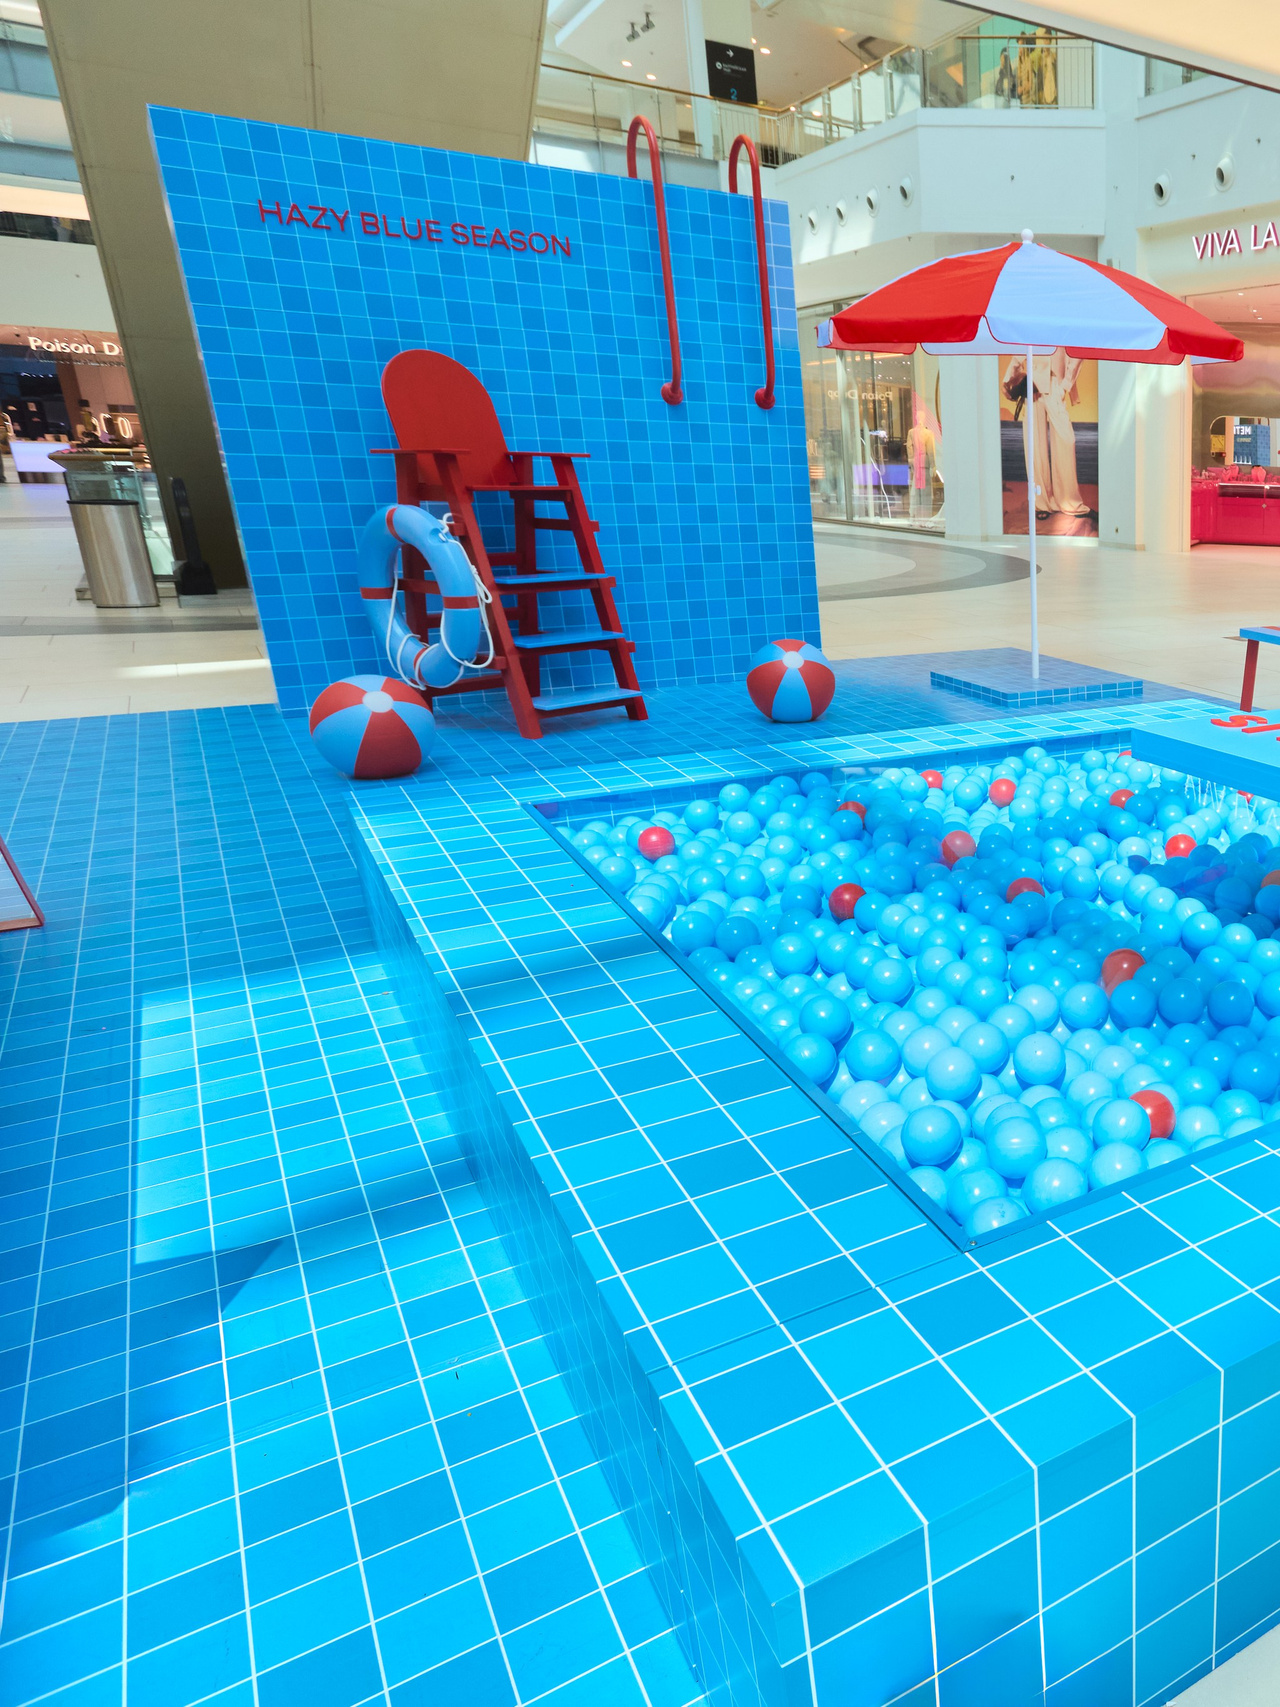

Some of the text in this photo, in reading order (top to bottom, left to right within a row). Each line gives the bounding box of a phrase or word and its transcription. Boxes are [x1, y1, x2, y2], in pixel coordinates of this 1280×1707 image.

[730, 88, 737, 100] 2
[257, 199, 571, 257] HAZY BLUE SEASON
[1192, 228, 1242, 260] VIVA
[1250, 221, 1280, 250] LA
[28, 336, 96, 355] Poison
